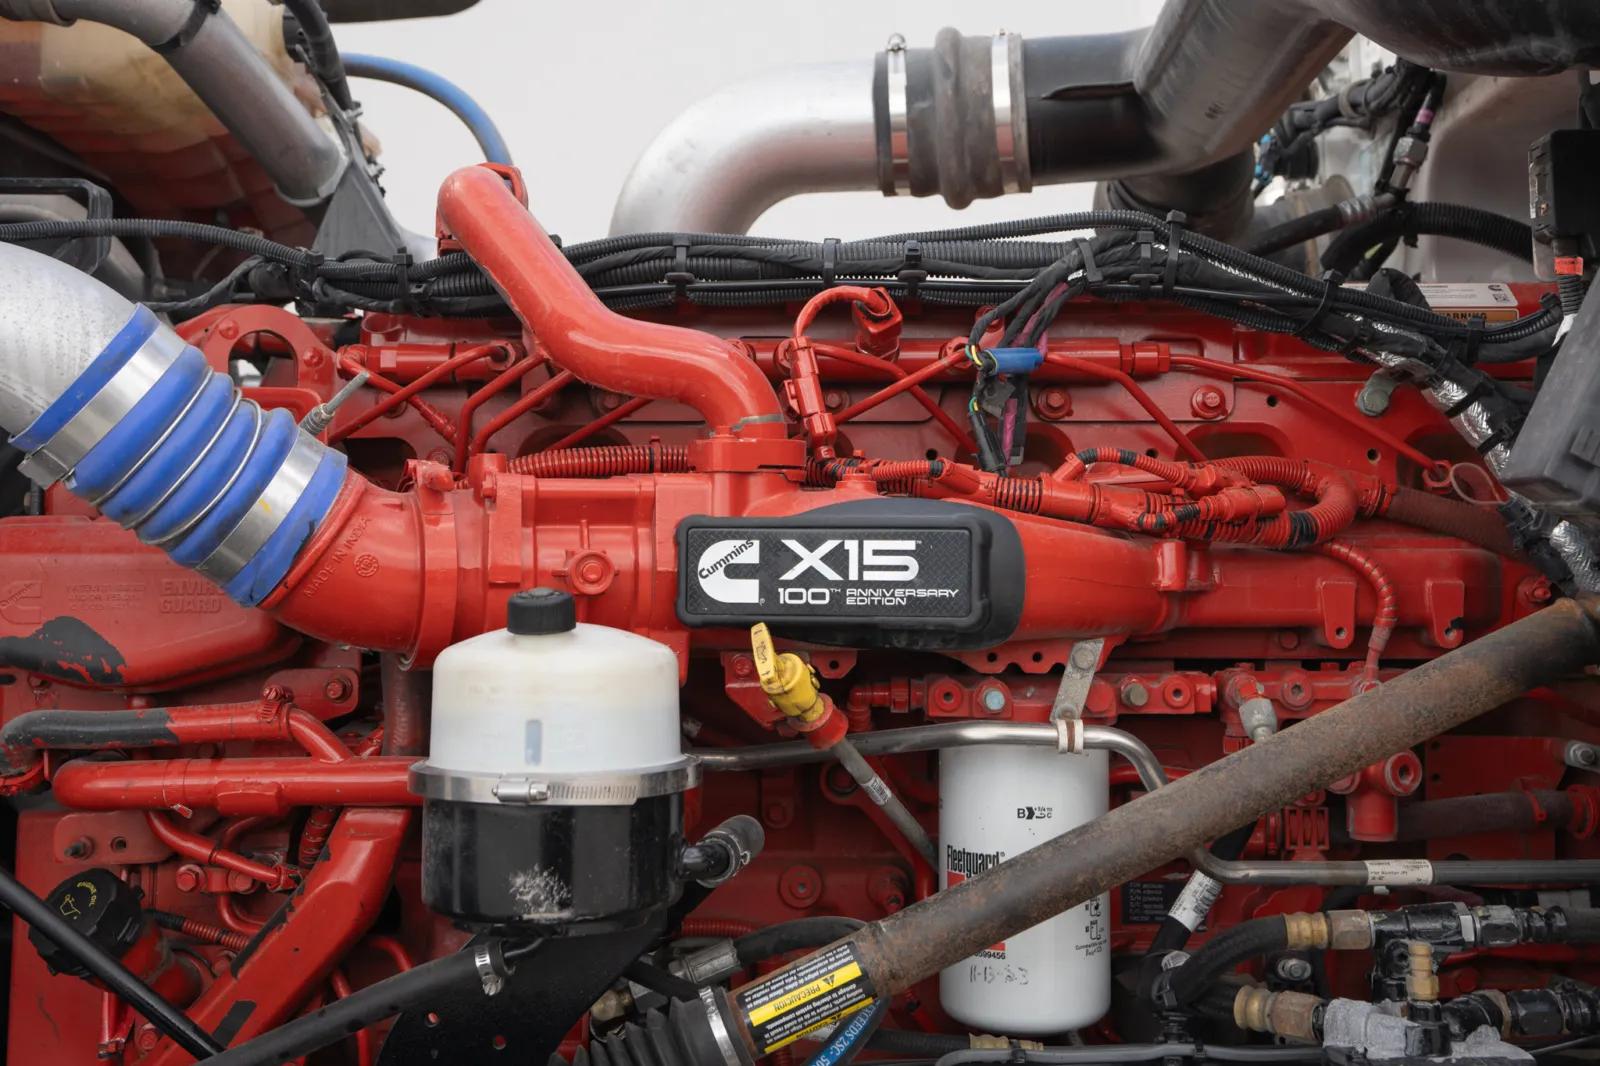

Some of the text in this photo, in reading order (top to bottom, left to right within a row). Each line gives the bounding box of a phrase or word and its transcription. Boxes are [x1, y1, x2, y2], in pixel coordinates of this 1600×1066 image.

[1442, 312, 1488, 320] ARNING
[699, 537, 754, 579] Cummins
[846, 588, 959, 598] ANNIVERSARY
[160, 598, 222, 614] GUARD
[846, 597, 907, 606] EDITION
[947, 845, 1000, 879] Fleetguard
